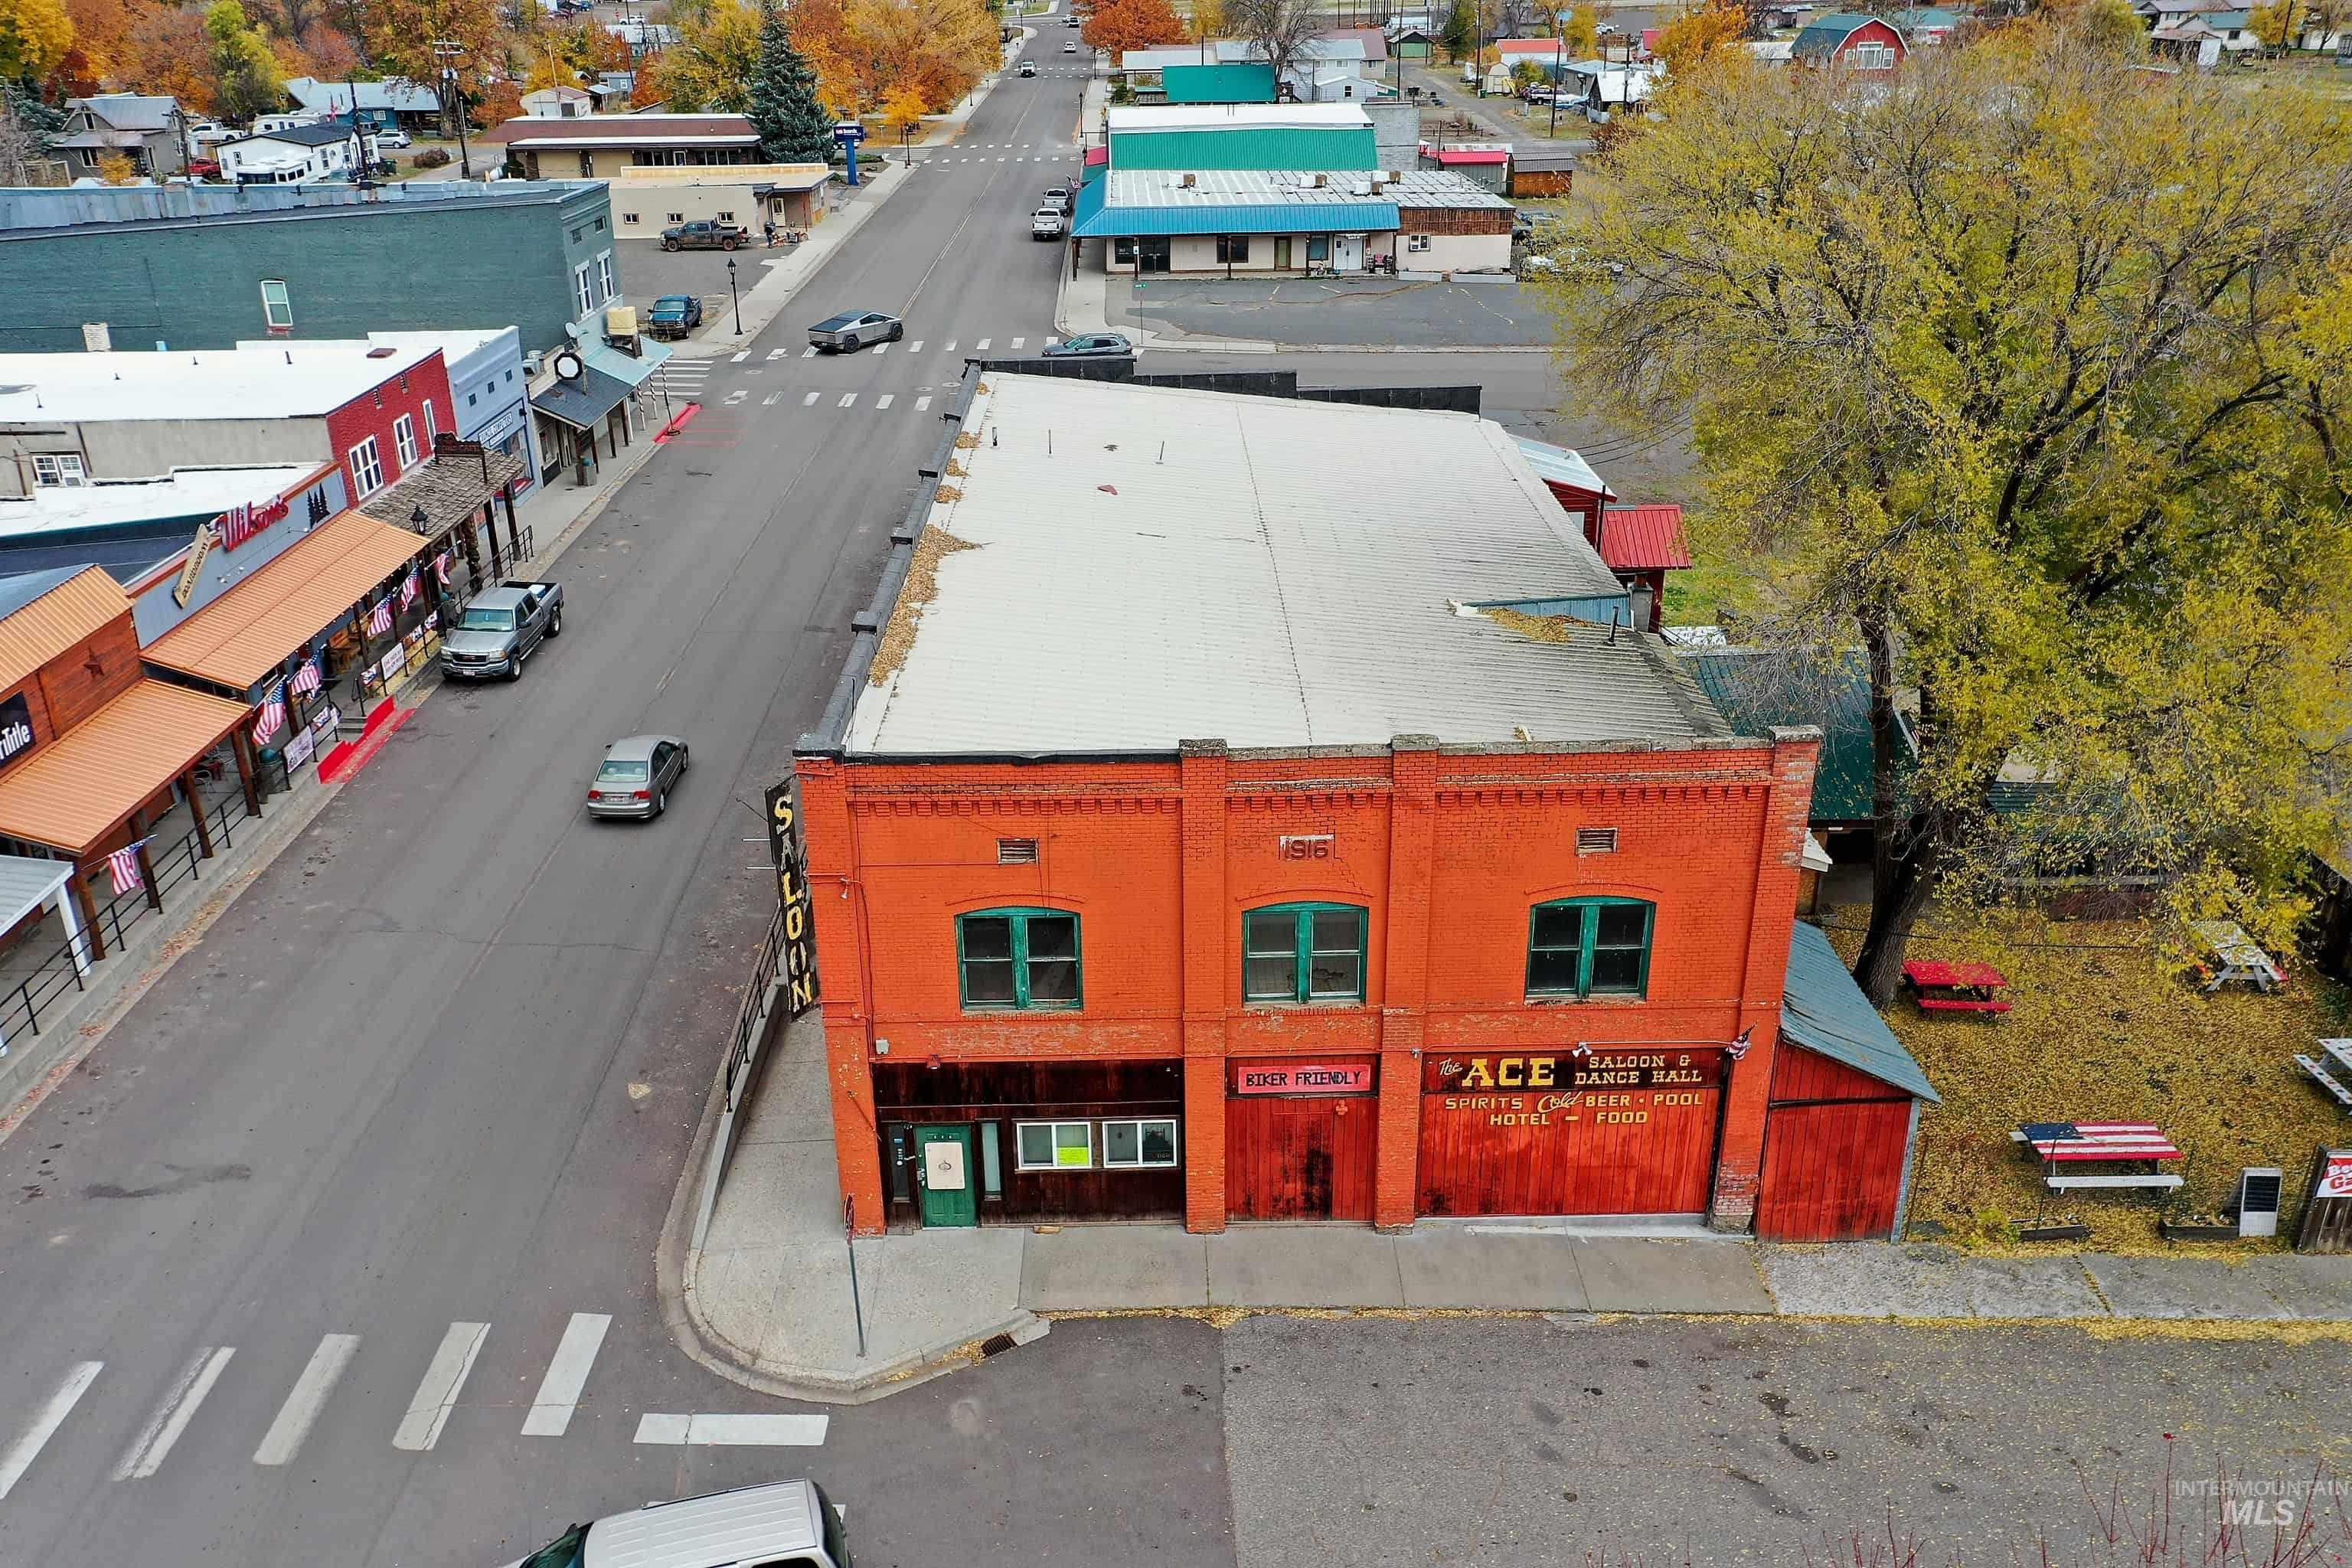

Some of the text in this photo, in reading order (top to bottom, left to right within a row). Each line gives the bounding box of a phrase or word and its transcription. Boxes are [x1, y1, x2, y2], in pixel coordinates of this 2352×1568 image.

[211, 495, 289, 551] Wilson's
[1283, 838, 1330, 858] 1916
[774, 793, 812, 1013] SALOON
[1589, 1054, 1691, 1068] SALOON &
[1246, 1071, 1361, 1087] BIKER FRIENDLY
[1439, 1057, 1555, 1086] The ACE
[1575, 1070, 1702, 1085] DANCE HALL
[1446, 1097, 1524, 1109] SPIRITS
[1537, 1092, 1584, 1113] Cold
[1586, 1095, 1630, 1107] BEER
[1654, 1093, 1703, 1106] POOL
[1490, 1114, 1550, 1125] HOTEL
[1596, 1112, 1648, 1124] FOOD
